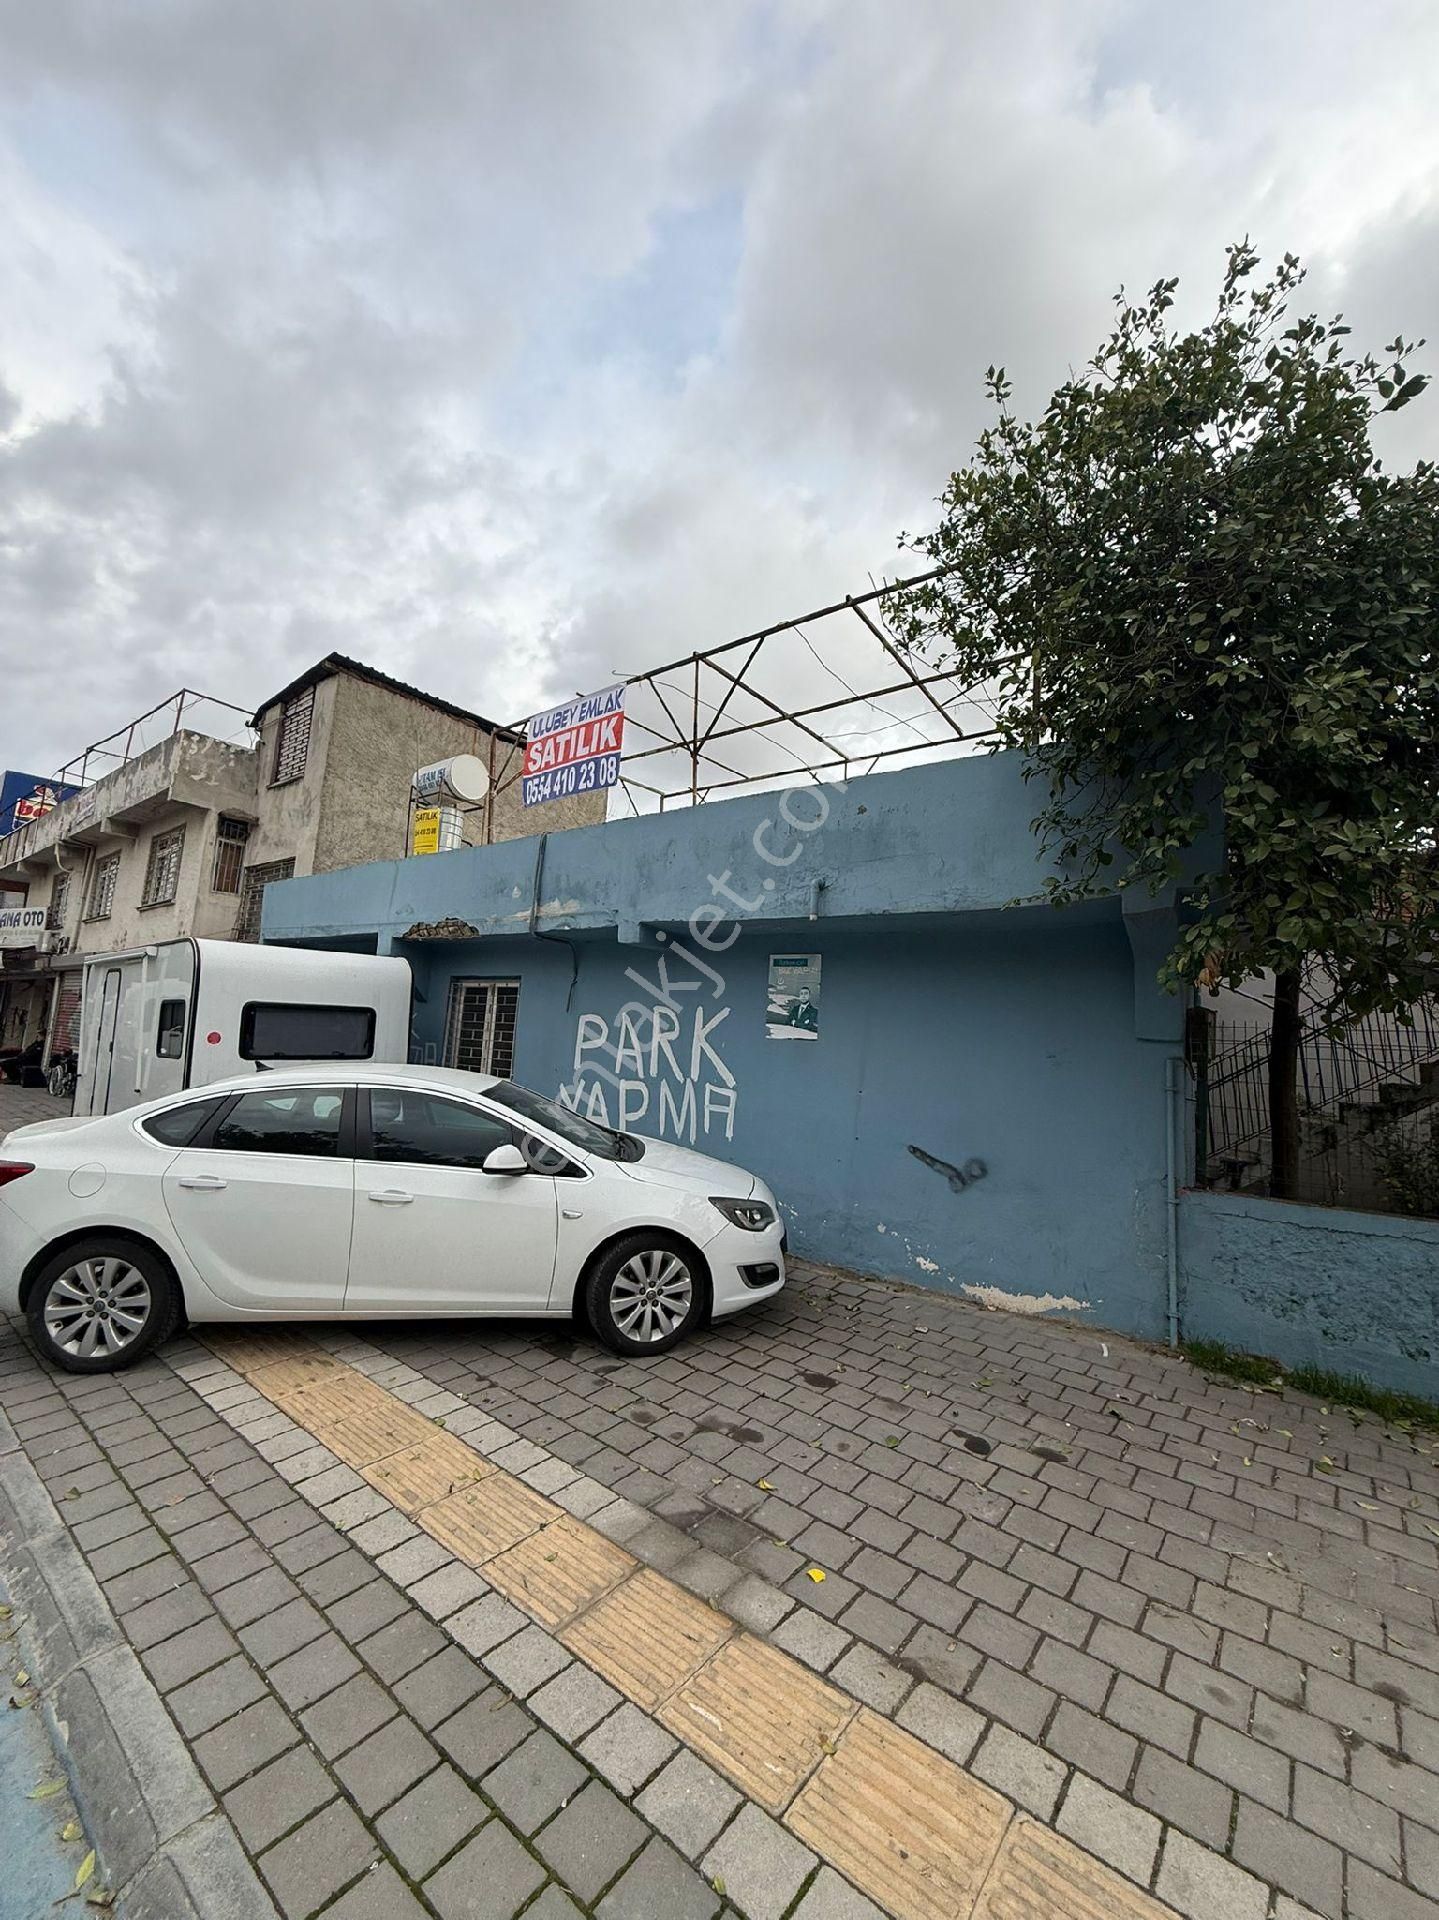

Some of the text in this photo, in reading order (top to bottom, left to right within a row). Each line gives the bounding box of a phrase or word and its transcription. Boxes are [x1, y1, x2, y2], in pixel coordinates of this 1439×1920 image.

[532, 688, 625, 738] ULUBEY EMLAK
[527, 715, 619, 772] SATILIK
[526, 756, 617, 805] 0554 410 23 08
[415, 811, 438, 823] SATILIK
[23, 911, 44, 927] OTO
[573, 1005, 737, 1089] PARK
[560, 1078, 737, 1145] YAPMA
